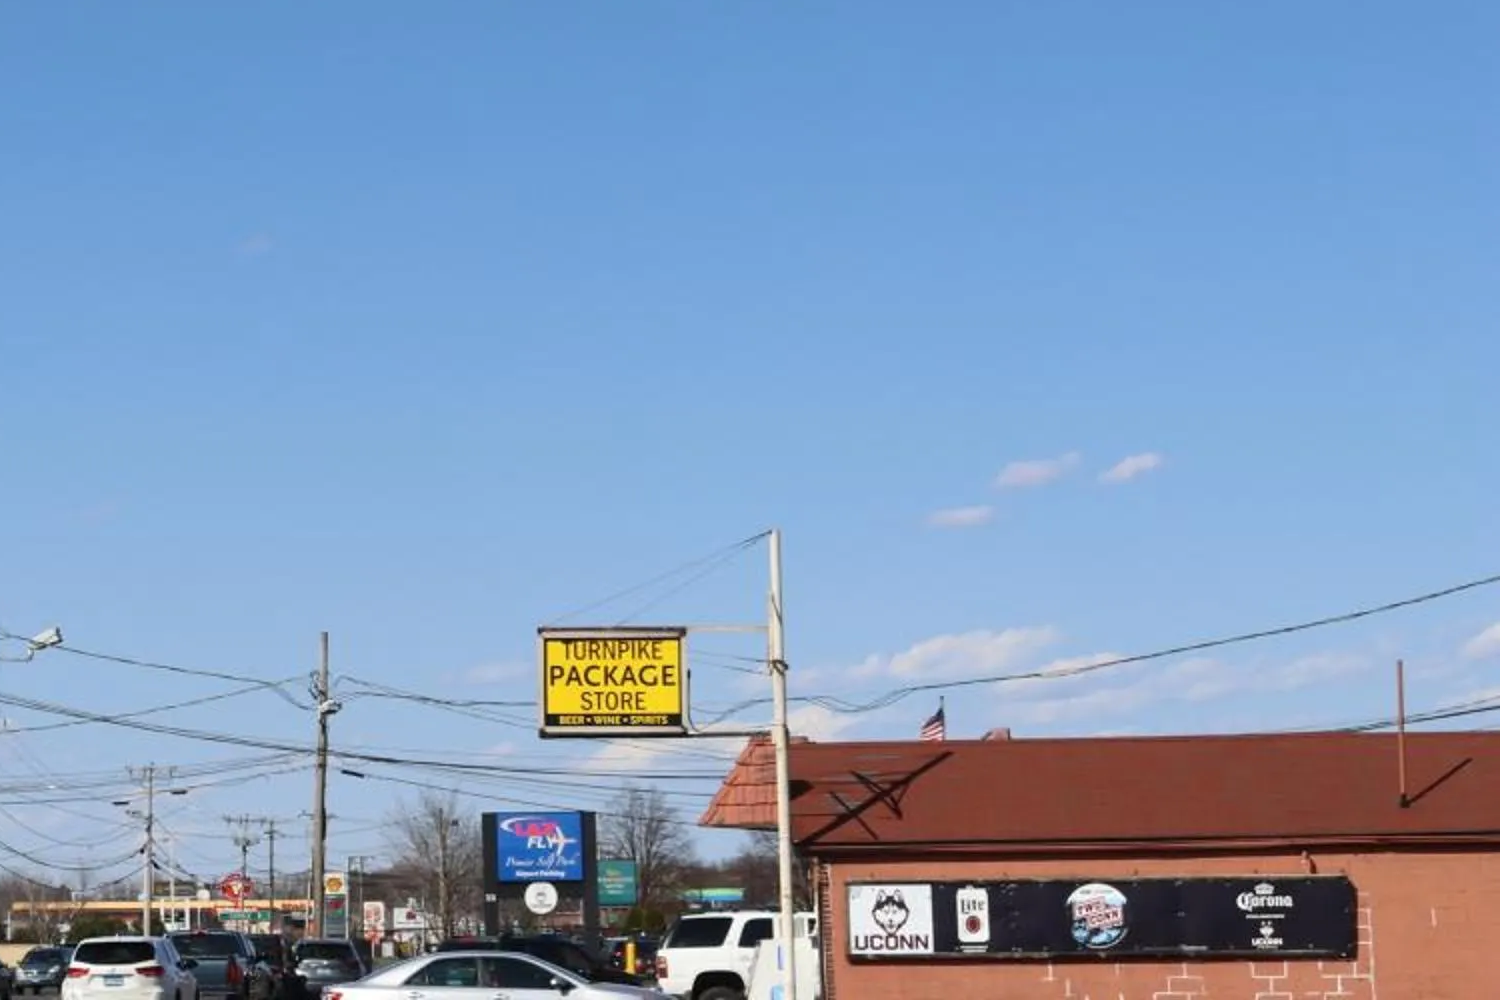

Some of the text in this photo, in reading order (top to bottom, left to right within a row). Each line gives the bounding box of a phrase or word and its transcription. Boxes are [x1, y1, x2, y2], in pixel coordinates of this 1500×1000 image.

[563, 640, 663, 660] TURNPIKE
[550, 665, 676, 687] PACKAGE
[580, 691, 647, 711] STORE
[560, 715, 669, 725] BEER WINE SPIRITS
[527, 836, 554, 849] FLY
[960, 899, 985, 914] Lite
[1236, 892, 1293, 912] Corona
[854, 935, 929, 950] UCONN
